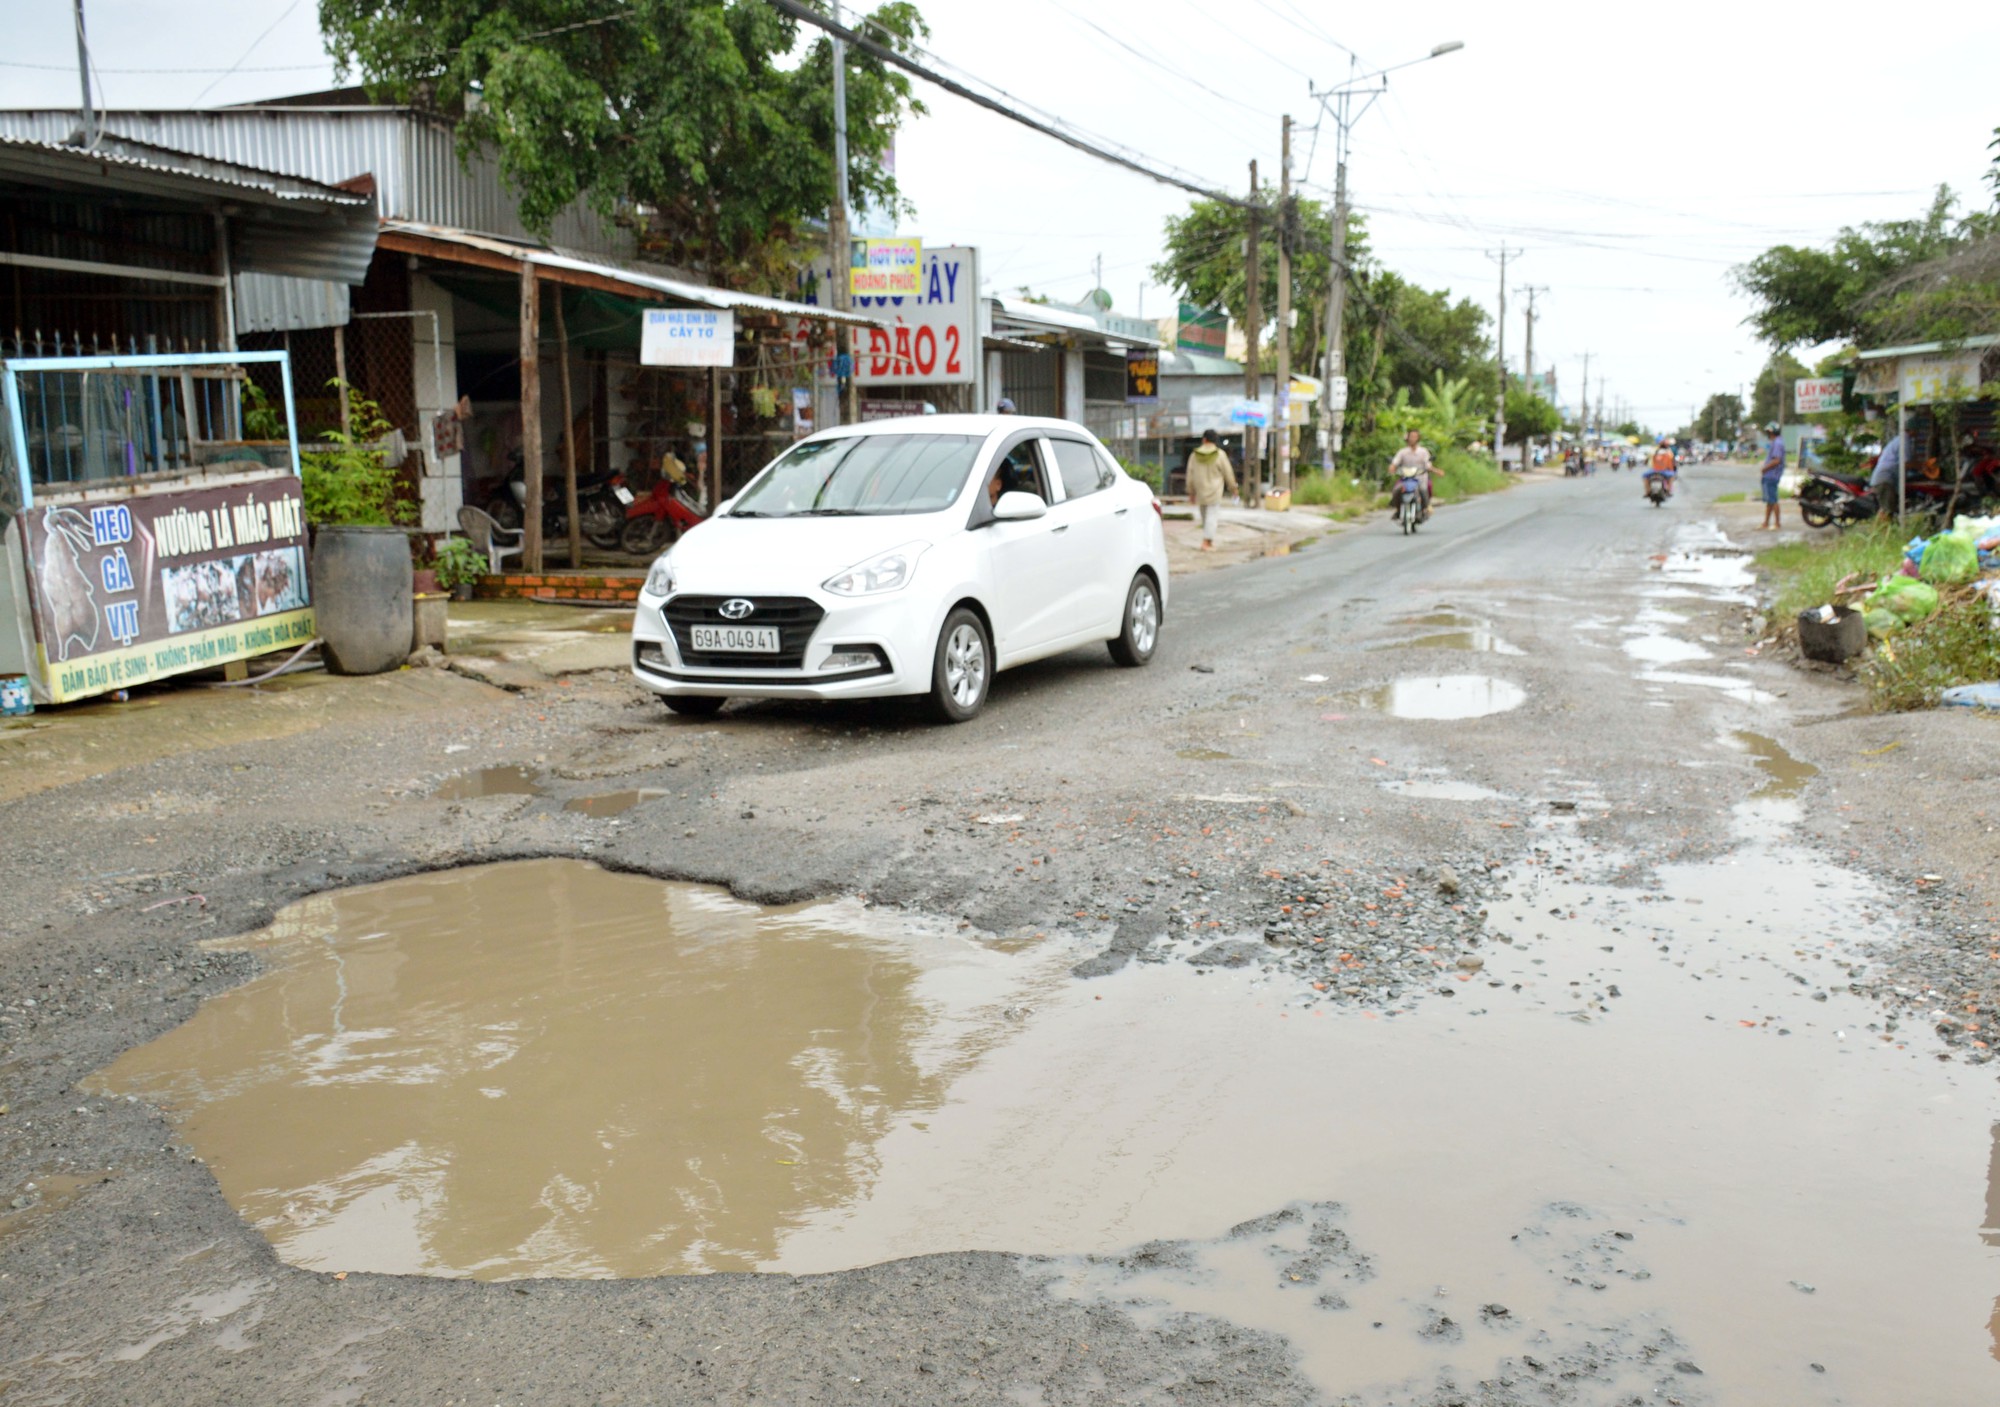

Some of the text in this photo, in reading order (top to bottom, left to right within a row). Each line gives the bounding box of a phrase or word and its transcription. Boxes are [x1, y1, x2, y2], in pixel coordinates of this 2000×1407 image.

[869, 316, 937, 377] ĐÀO
[945, 325, 961, 374] 2
[92, 505, 132, 545] HEO
[153, 493, 302, 558] NƯỚNG LÁ MẮC MẬT
[102, 548, 133, 592] GÀ
[106, 602, 138, 645] VỊT
[124, 655, 148, 679] SINH
[155, 644, 188, 671] KHÔNG
